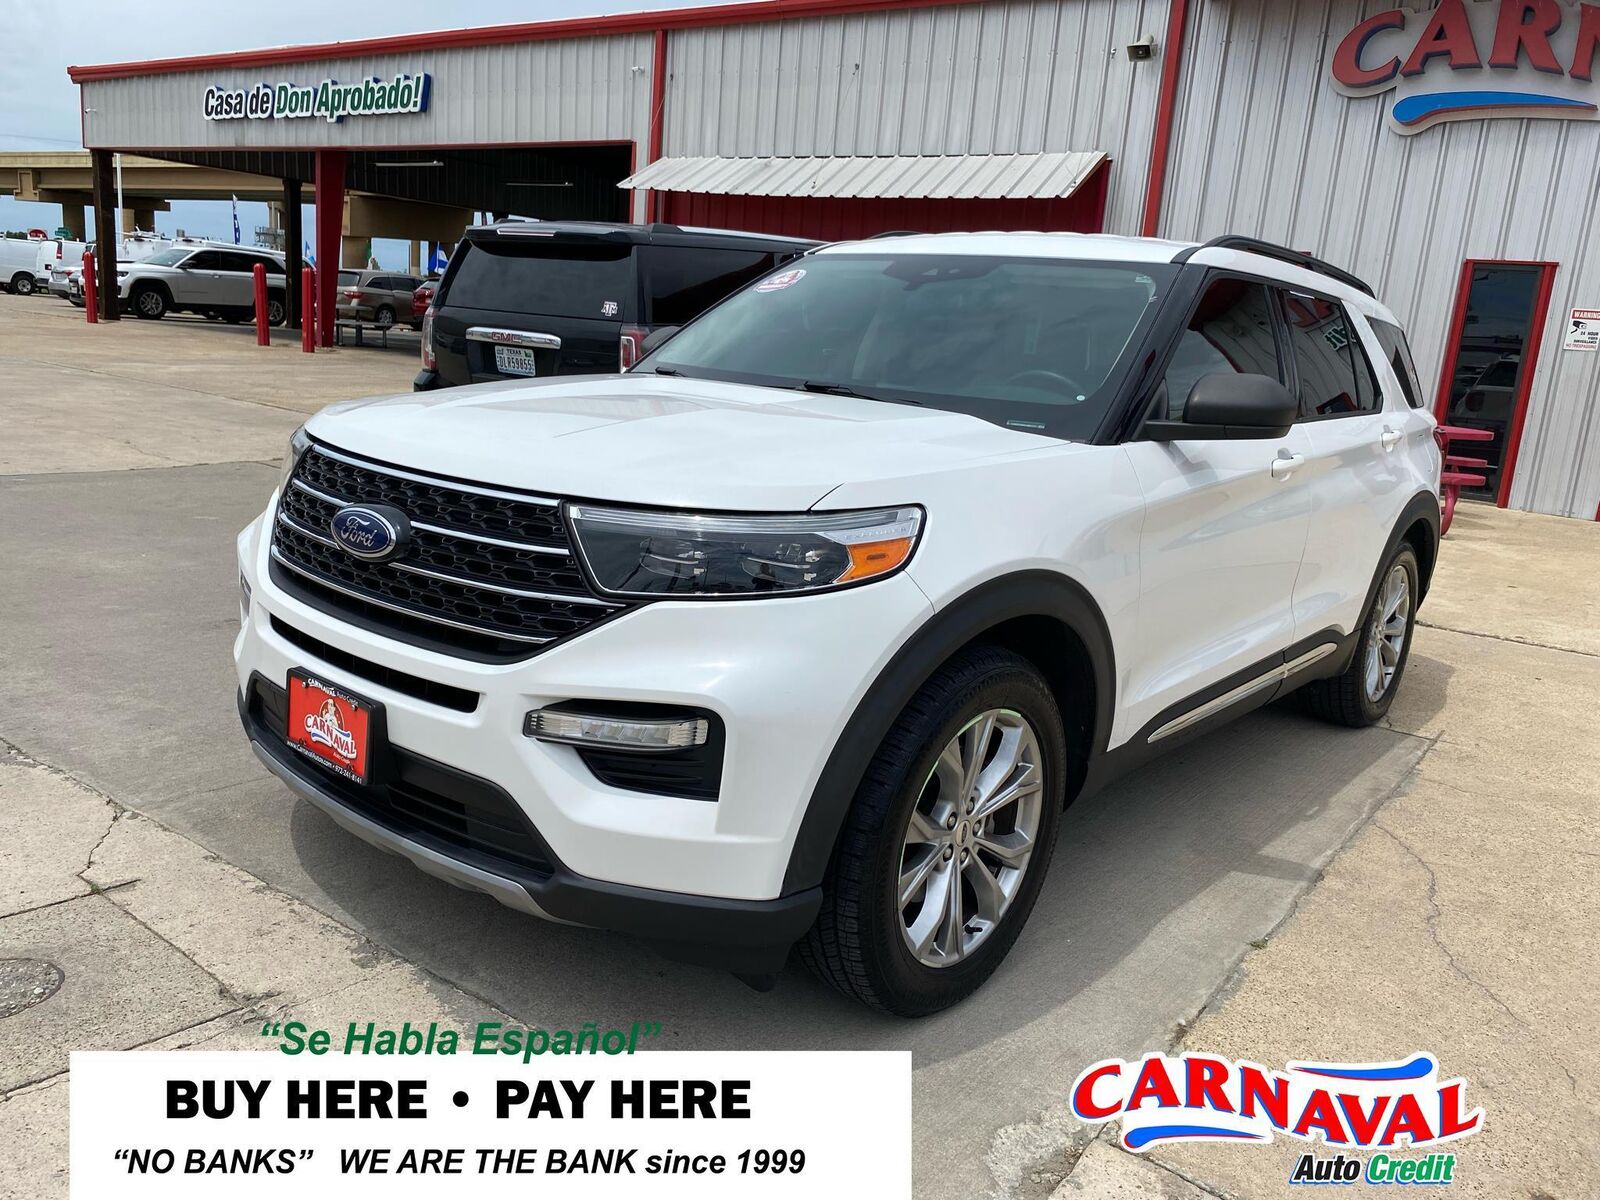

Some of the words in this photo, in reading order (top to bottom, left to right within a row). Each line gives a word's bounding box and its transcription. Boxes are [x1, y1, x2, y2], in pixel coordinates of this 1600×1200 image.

[204, 88, 244, 117] Casa
[248, 86, 271, 115] de
[276, 85, 311, 114] Don
[317, 75, 422, 120] Aprobado!
[491, 331, 522, 344] GMC
[340, 516, 378, 547] Ford
[307, 678, 336, 698] CARNAVAL
[304, 715, 356, 756] CARNAVAL
